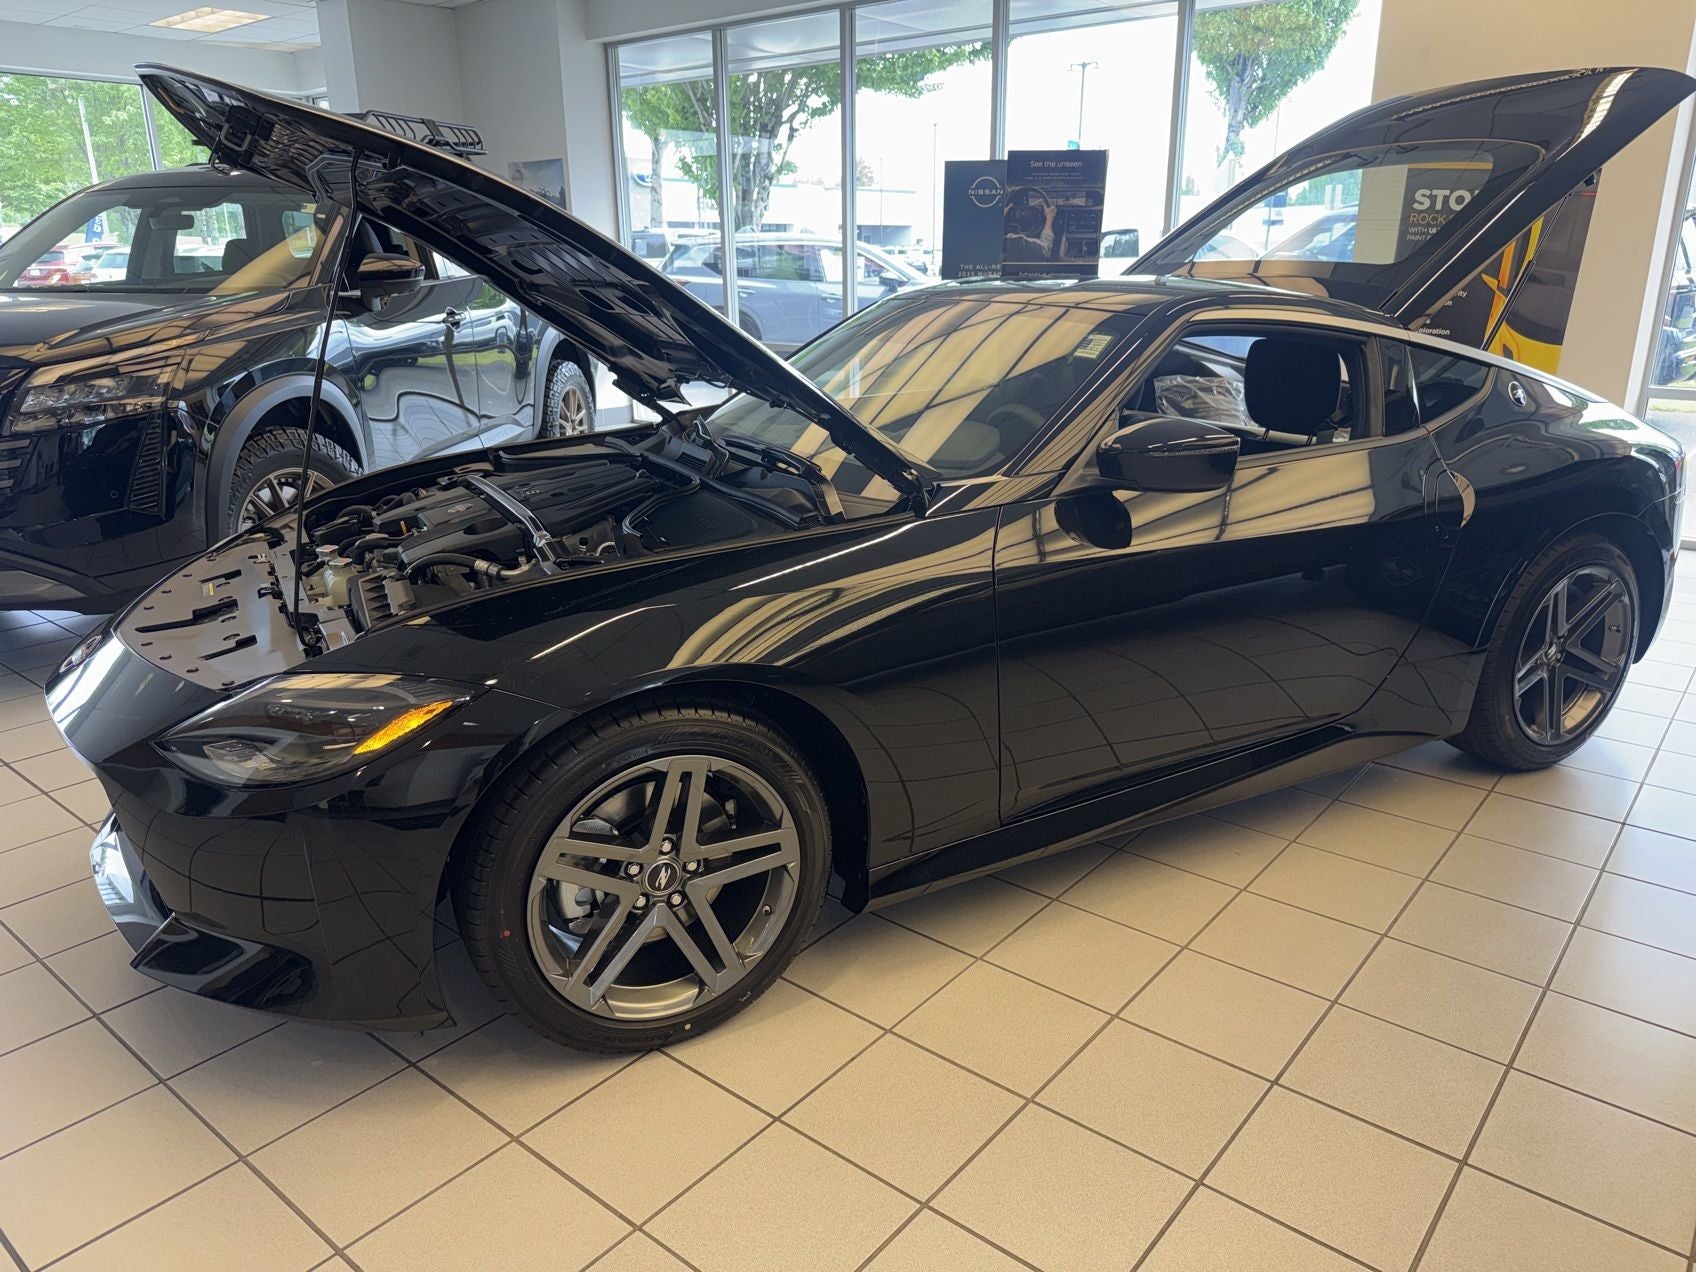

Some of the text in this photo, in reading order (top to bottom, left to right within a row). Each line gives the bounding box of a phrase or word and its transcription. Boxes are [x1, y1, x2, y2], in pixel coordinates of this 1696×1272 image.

[1030, 160, 1083, 168] See the unseen
[968, 188, 1004, 196] NISSAN
[1412, 188, 1479, 211] STO
[1409, 212, 1446, 225] ROCK
[1408, 226, 1428, 234] WITH
